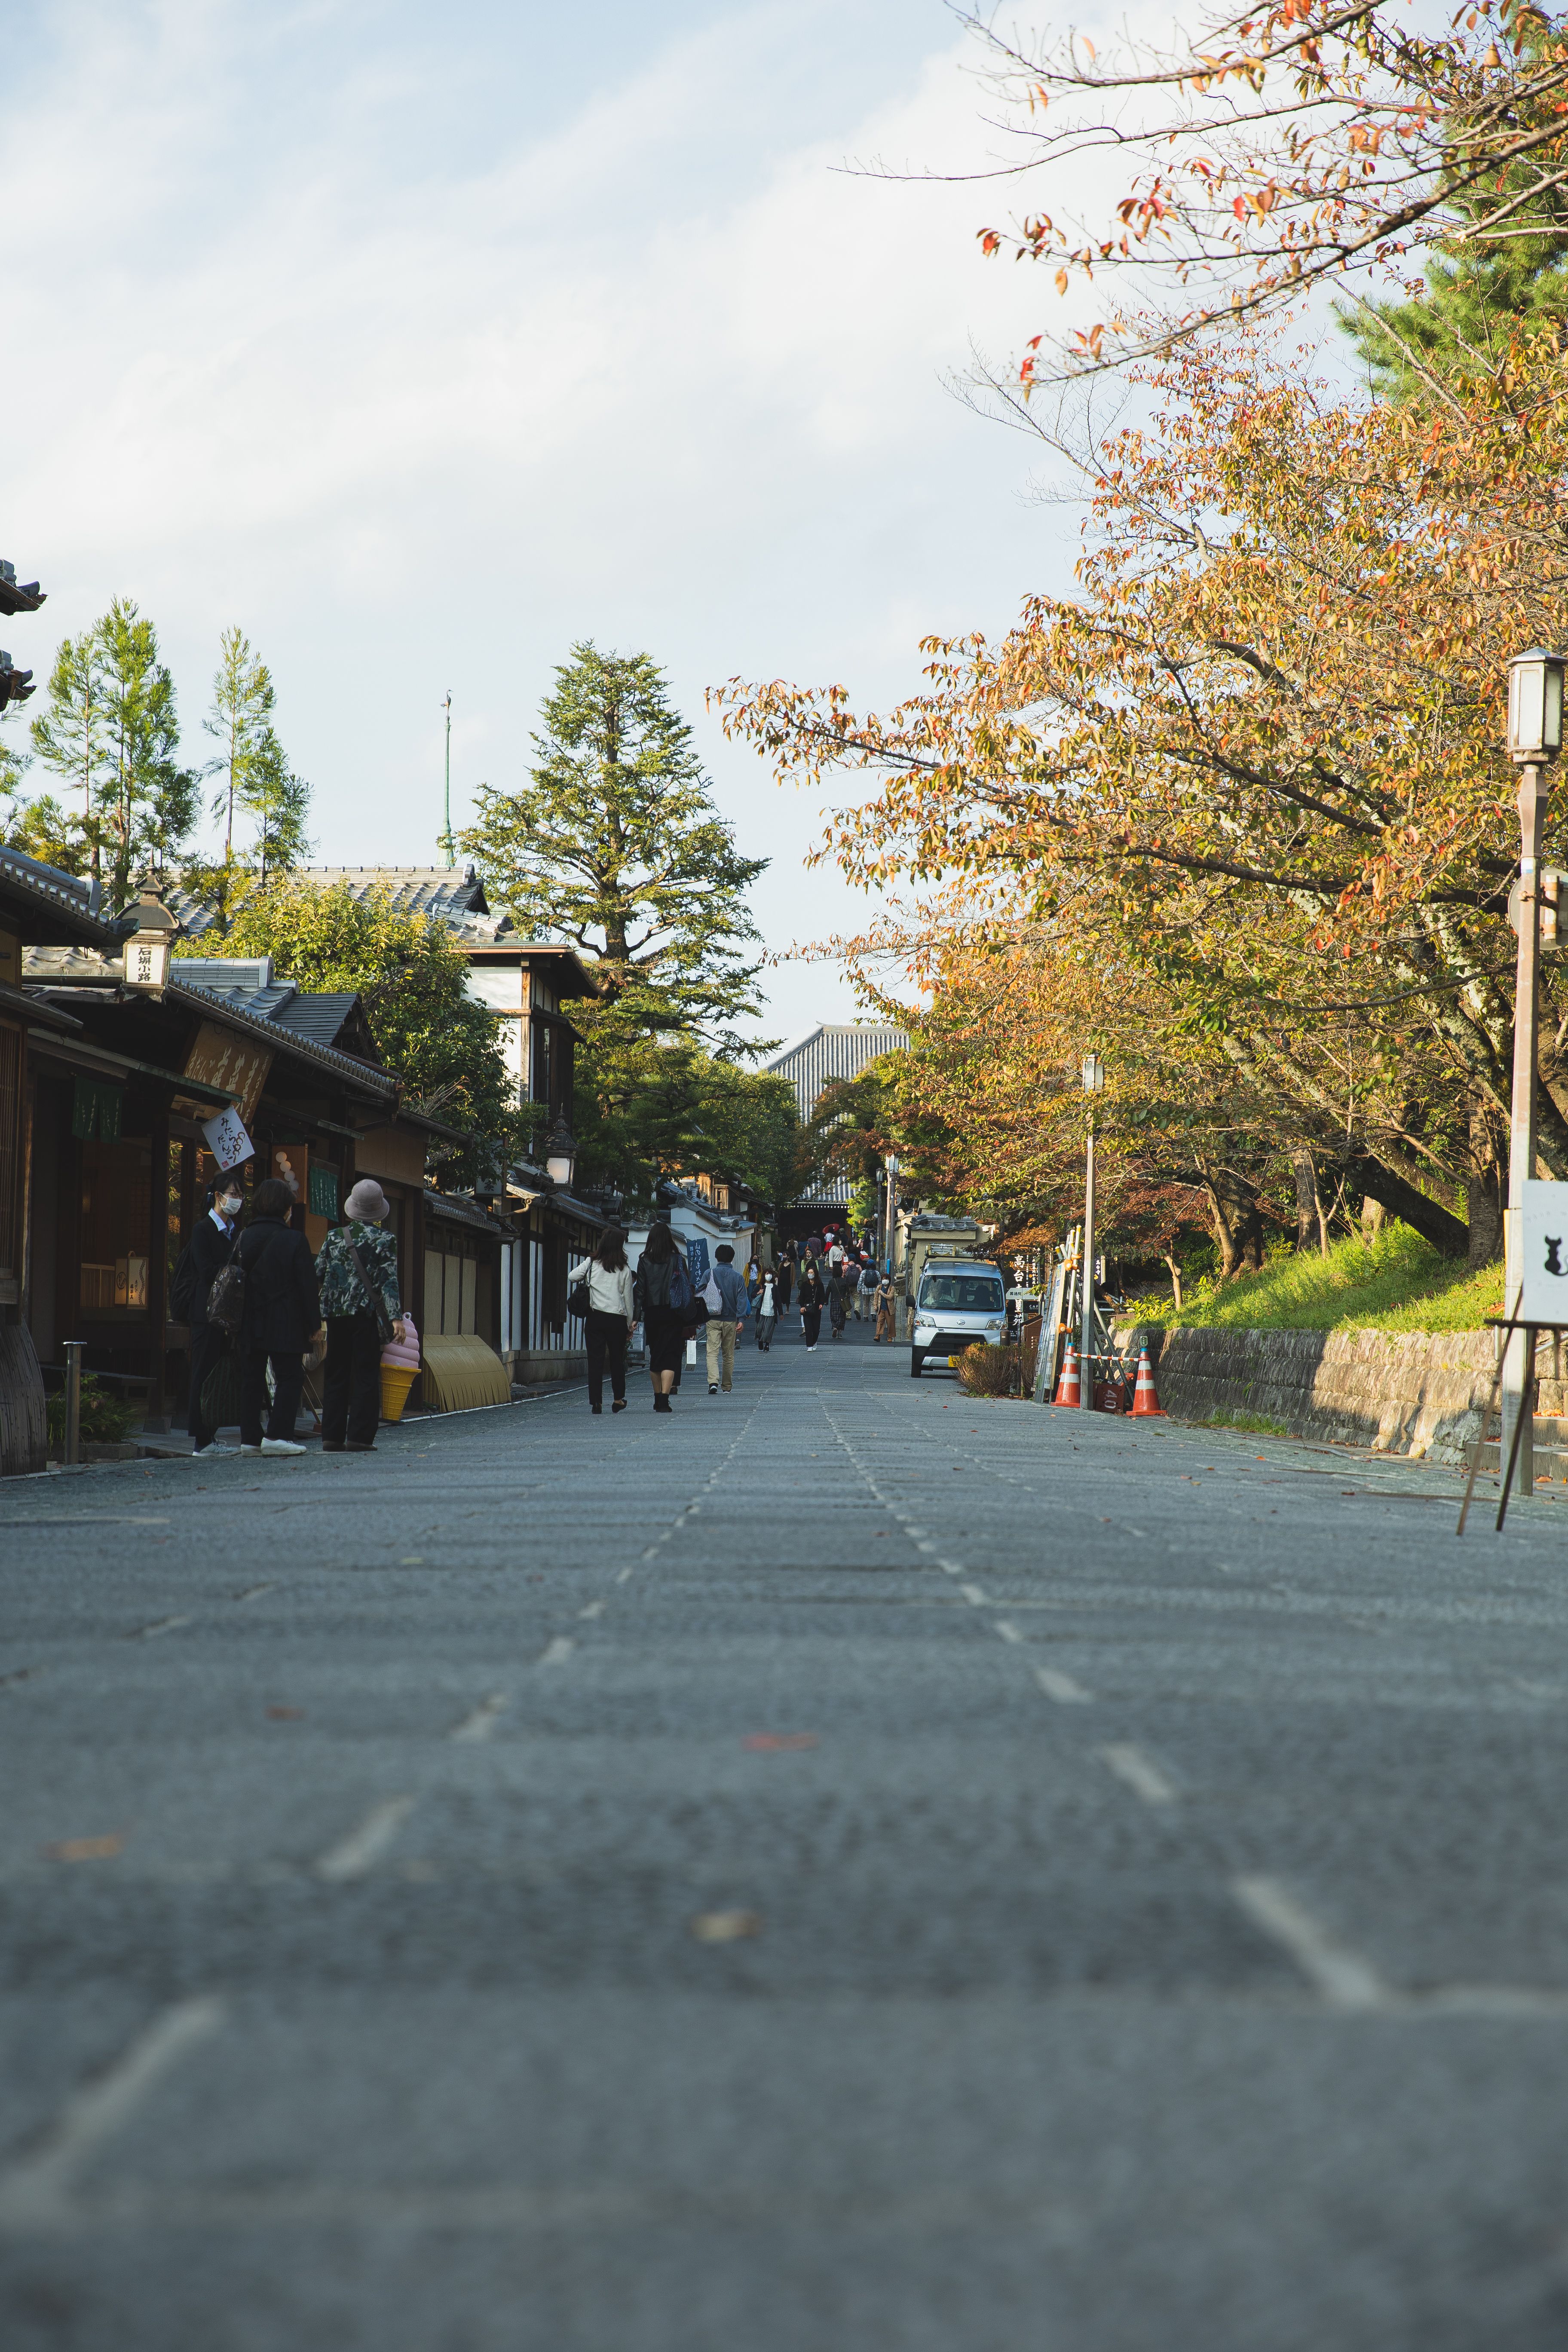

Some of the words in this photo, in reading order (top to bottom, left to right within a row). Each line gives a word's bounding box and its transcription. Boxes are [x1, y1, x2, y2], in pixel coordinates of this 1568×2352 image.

[138, 947, 152, 982] 石塀小路
[217, 1134, 233, 1159] だんご
[1105, 1390, 1117, 1409] 40
